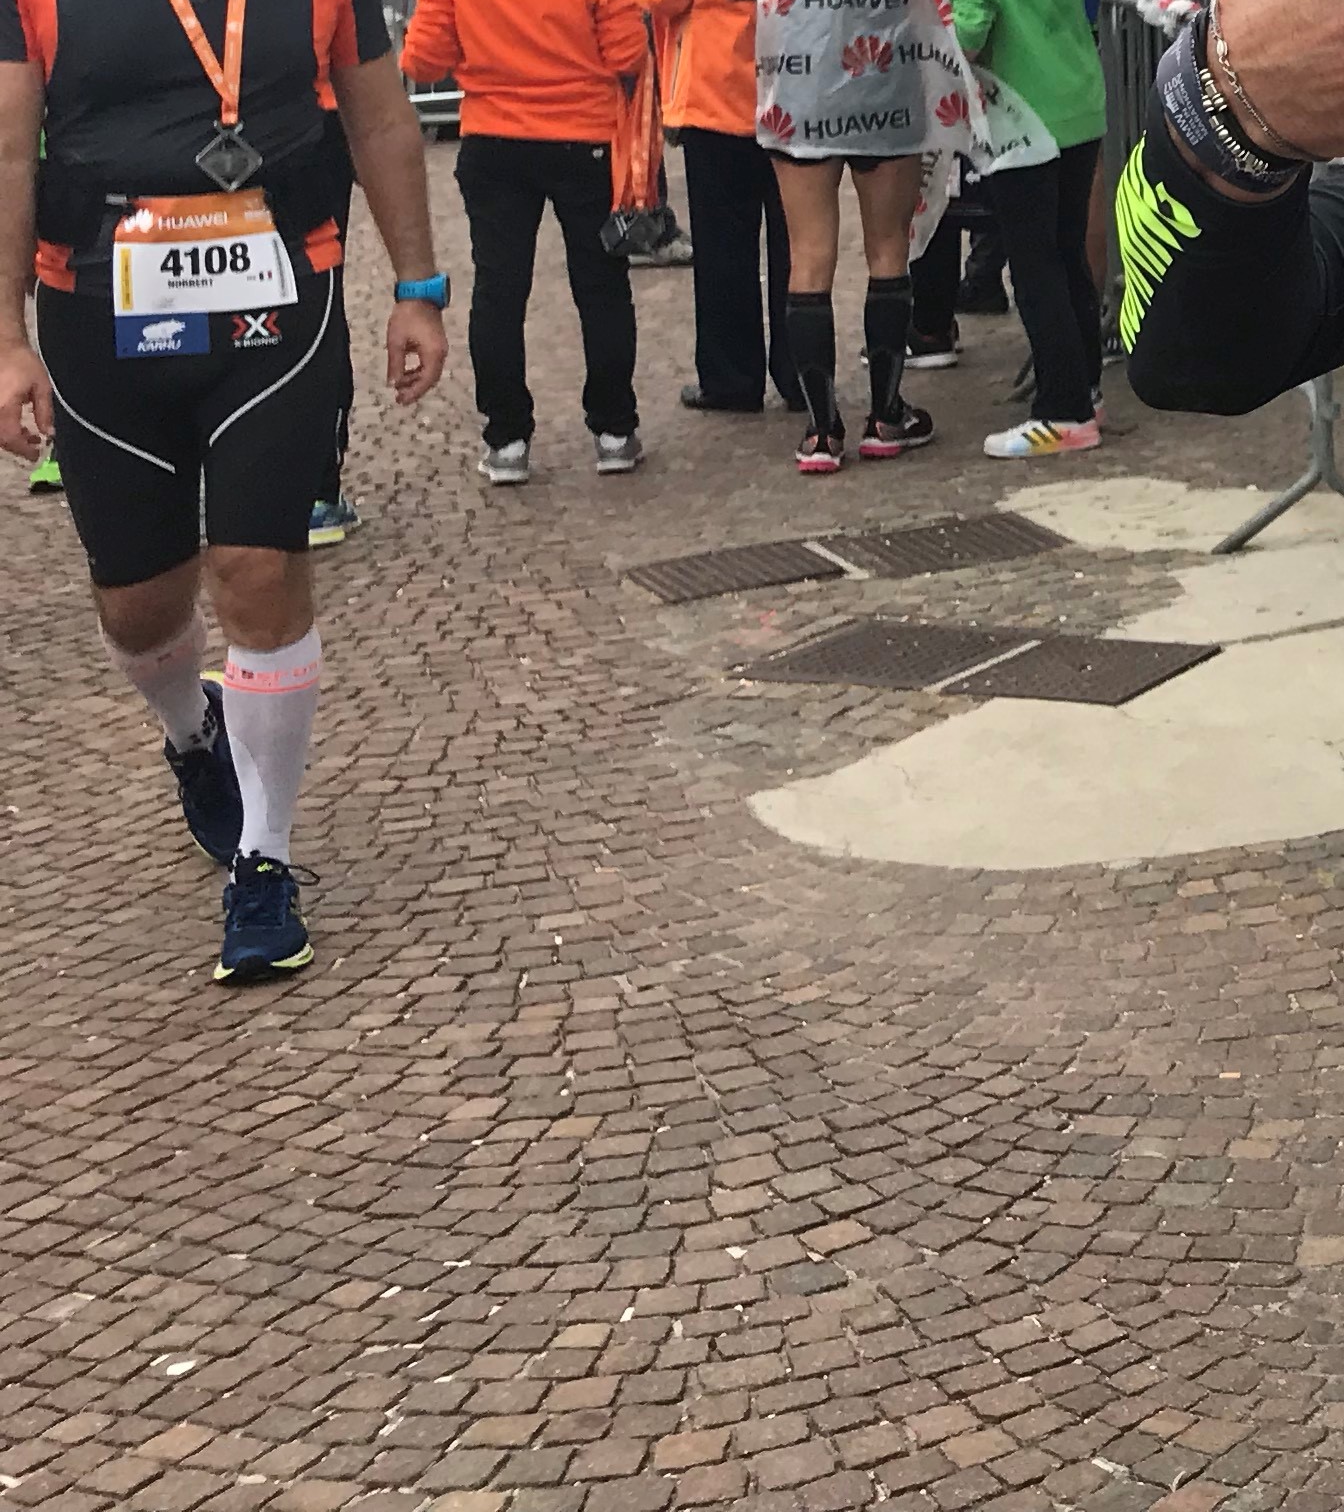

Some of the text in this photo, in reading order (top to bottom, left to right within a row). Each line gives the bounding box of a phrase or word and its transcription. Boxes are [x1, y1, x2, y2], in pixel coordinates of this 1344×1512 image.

[804, 108, 911, 140] HUAWEI
[158, 211, 228, 230] HUAWEI
[160, 242, 251, 277] 4108
